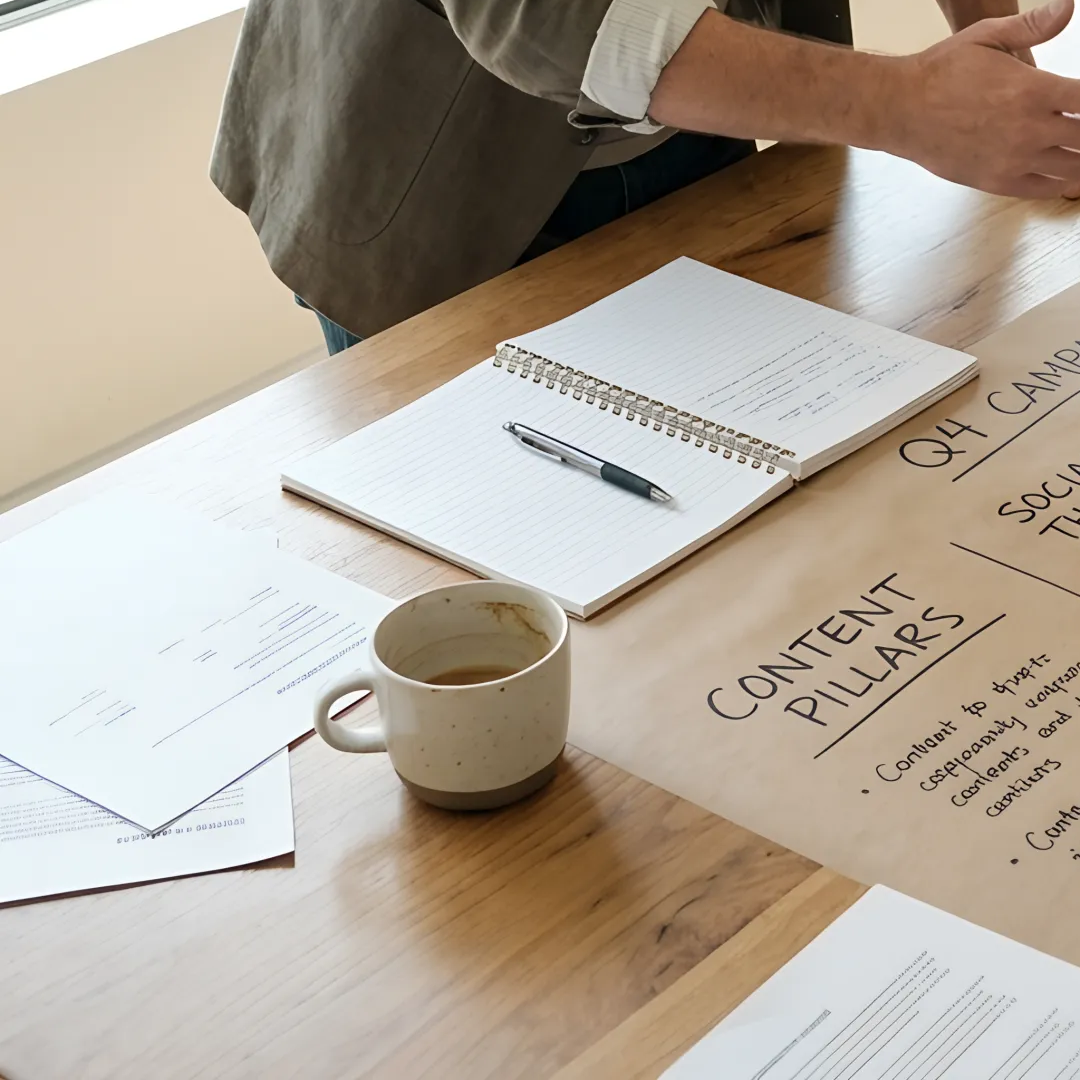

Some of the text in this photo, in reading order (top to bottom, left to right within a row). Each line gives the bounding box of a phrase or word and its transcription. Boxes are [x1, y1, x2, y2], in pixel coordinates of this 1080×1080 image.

[898, 417, 989, 469] Q4
[706, 572, 916, 721] CONTENT
[783, 606, 965, 727] PILLARS
